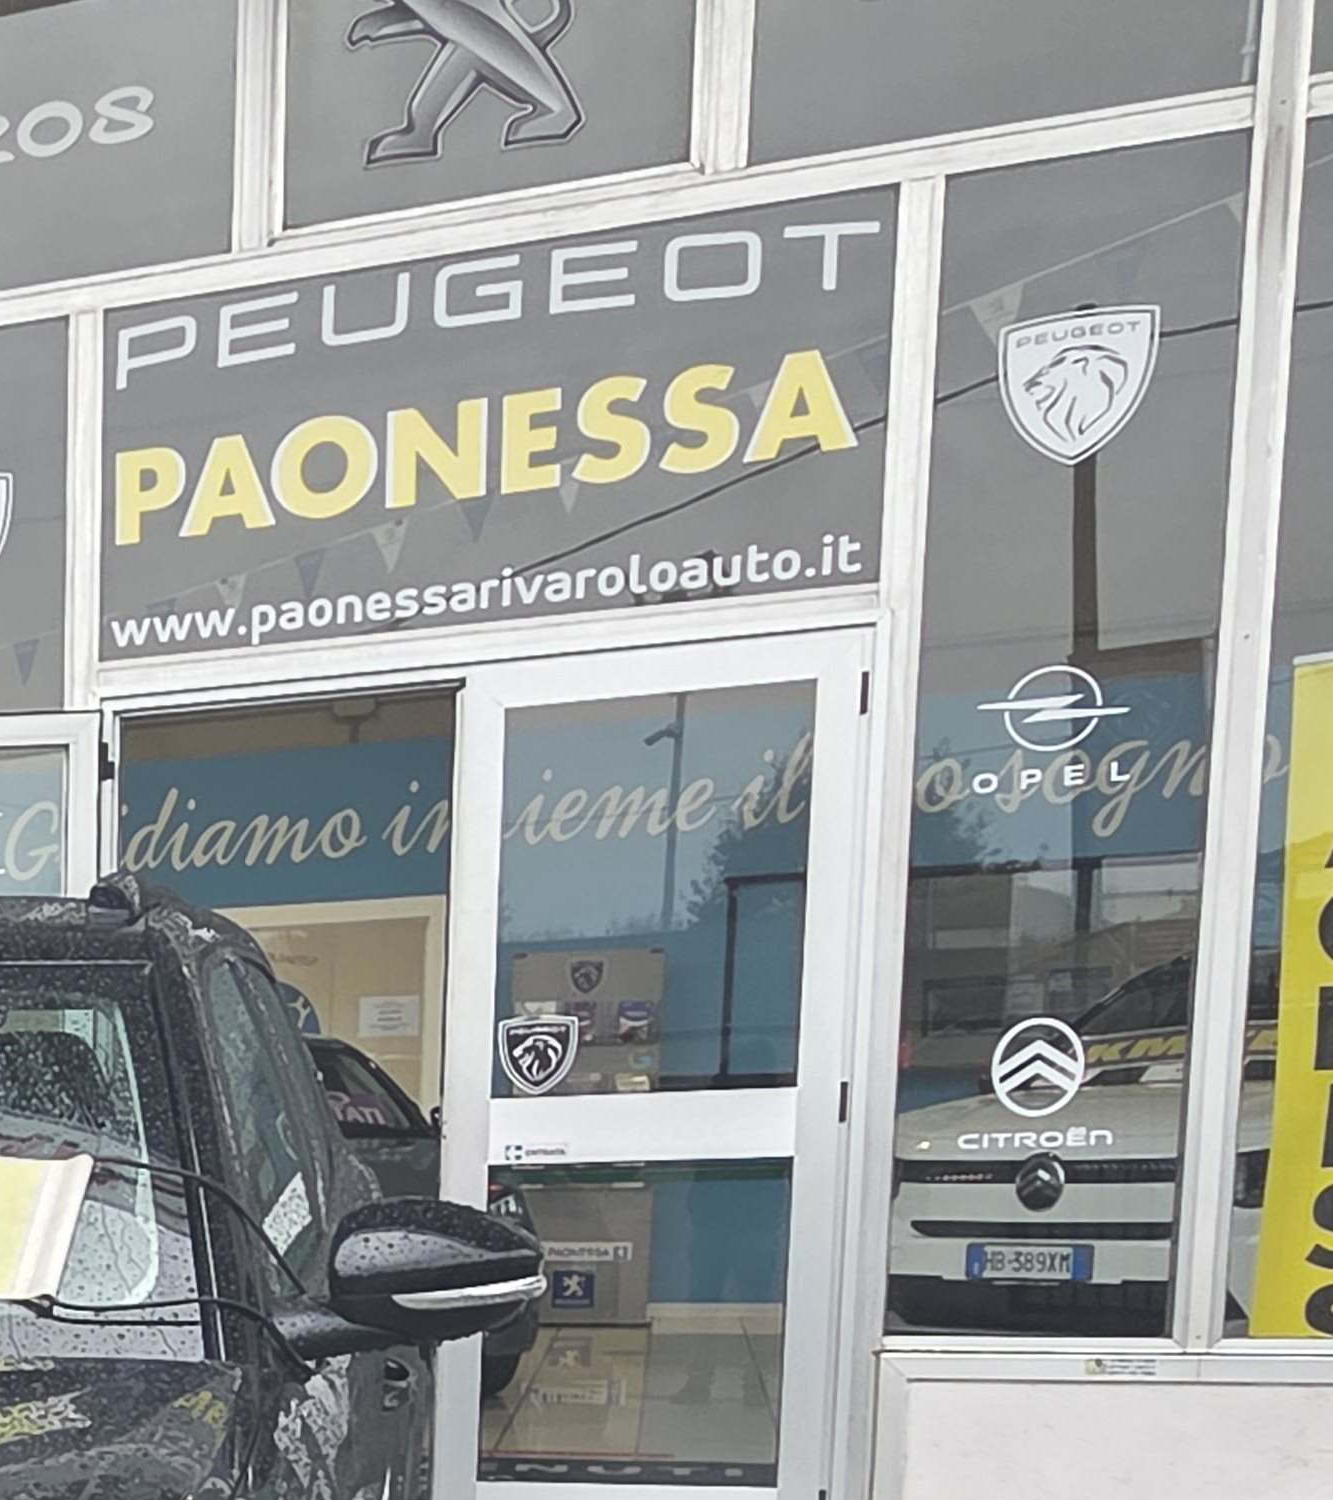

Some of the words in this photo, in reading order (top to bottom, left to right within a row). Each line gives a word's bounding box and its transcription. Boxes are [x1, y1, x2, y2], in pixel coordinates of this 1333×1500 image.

[115, 220, 881, 390] PEUGEOT
[1016, 320, 1141, 349] PEUGEOT
[114, 349, 859, 546] PAONESSA
[110, 533, 863, 648] www.paonessarivaroloauto.it
[971, 761, 1131, 795] OPEL
[957, 1126, 1114, 1150] CITROËN
